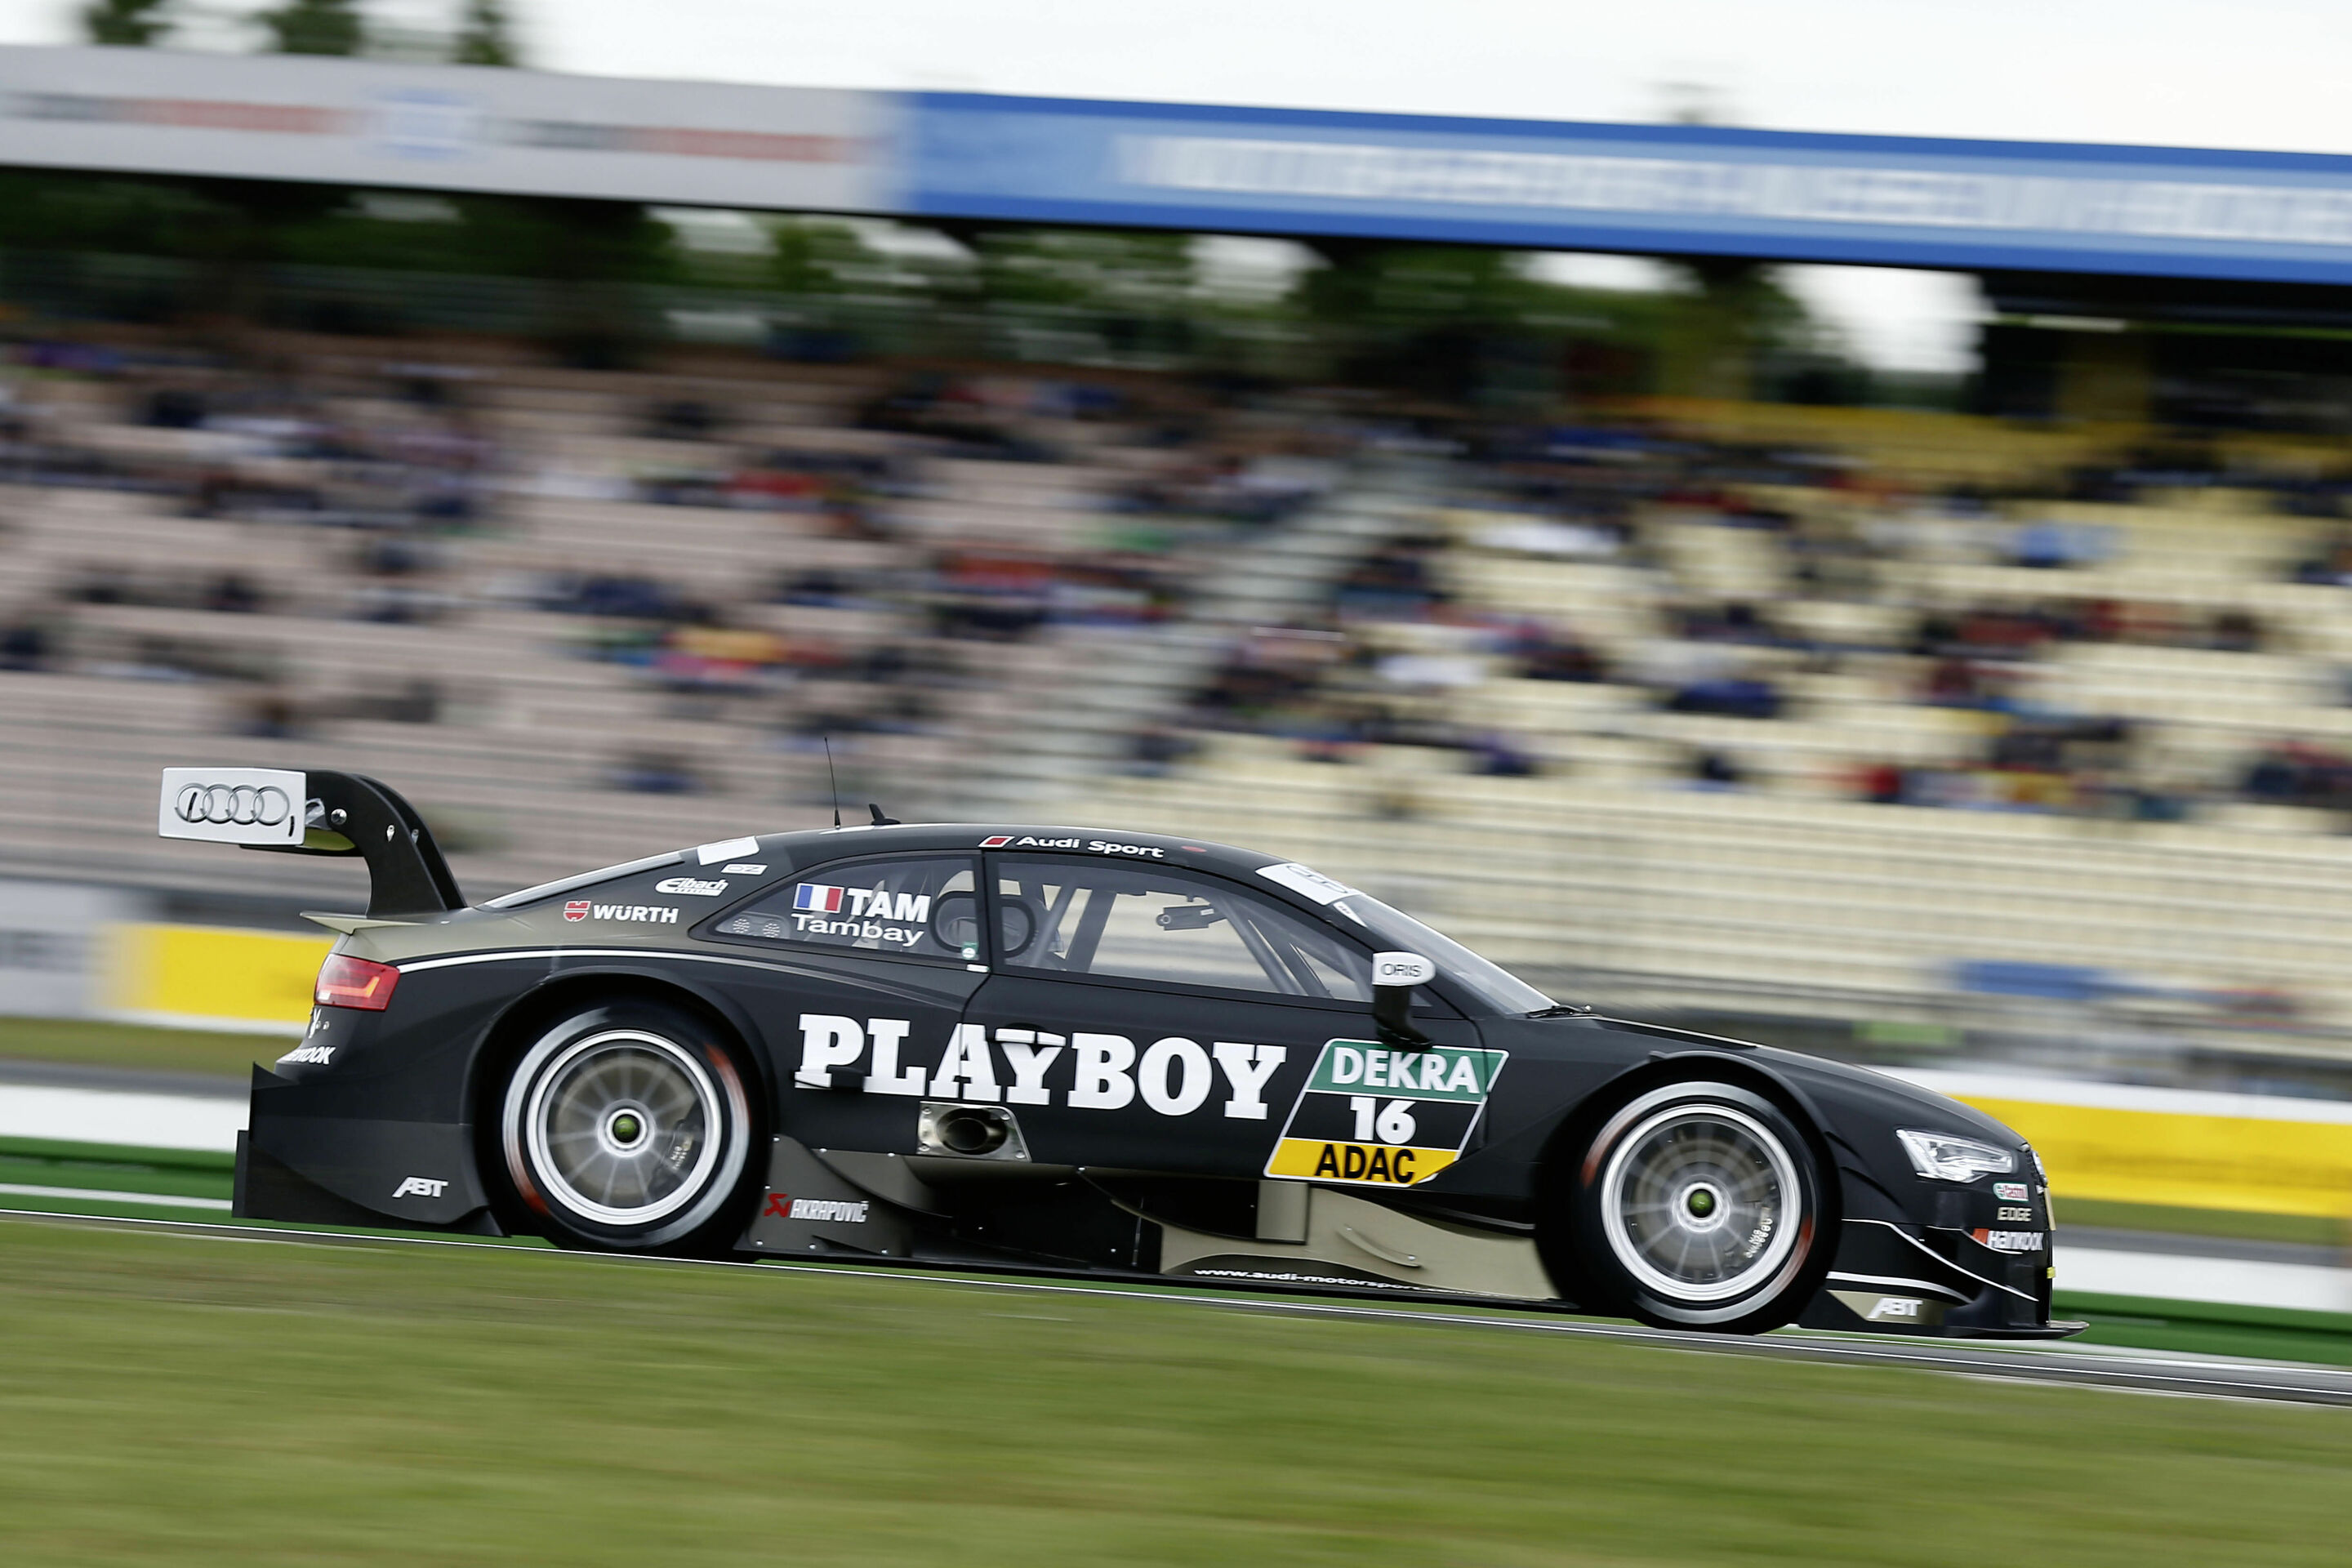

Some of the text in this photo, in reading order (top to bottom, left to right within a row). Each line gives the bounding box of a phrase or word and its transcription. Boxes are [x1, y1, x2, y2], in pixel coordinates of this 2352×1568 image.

[1016, 835, 1165, 858] Audi Sport
[593, 904, 679, 924] WÜRTH
[847, 887, 932, 923] TAM
[791, 912, 924, 947] Tambay
[1380, 963, 1423, 978] ORIS
[795, 1013, 1287, 1120] PLAYBOY
[1331, 1046, 1481, 1094] DEKRA
[1349, 1096, 1417, 1145] 16
[1313, 1143, 1416, 1184] ADAC
[392, 1176, 449, 1198] ABT
[1997, 1206, 2033, 1222] EDGE
[1867, 1297, 1924, 1320] ABT
